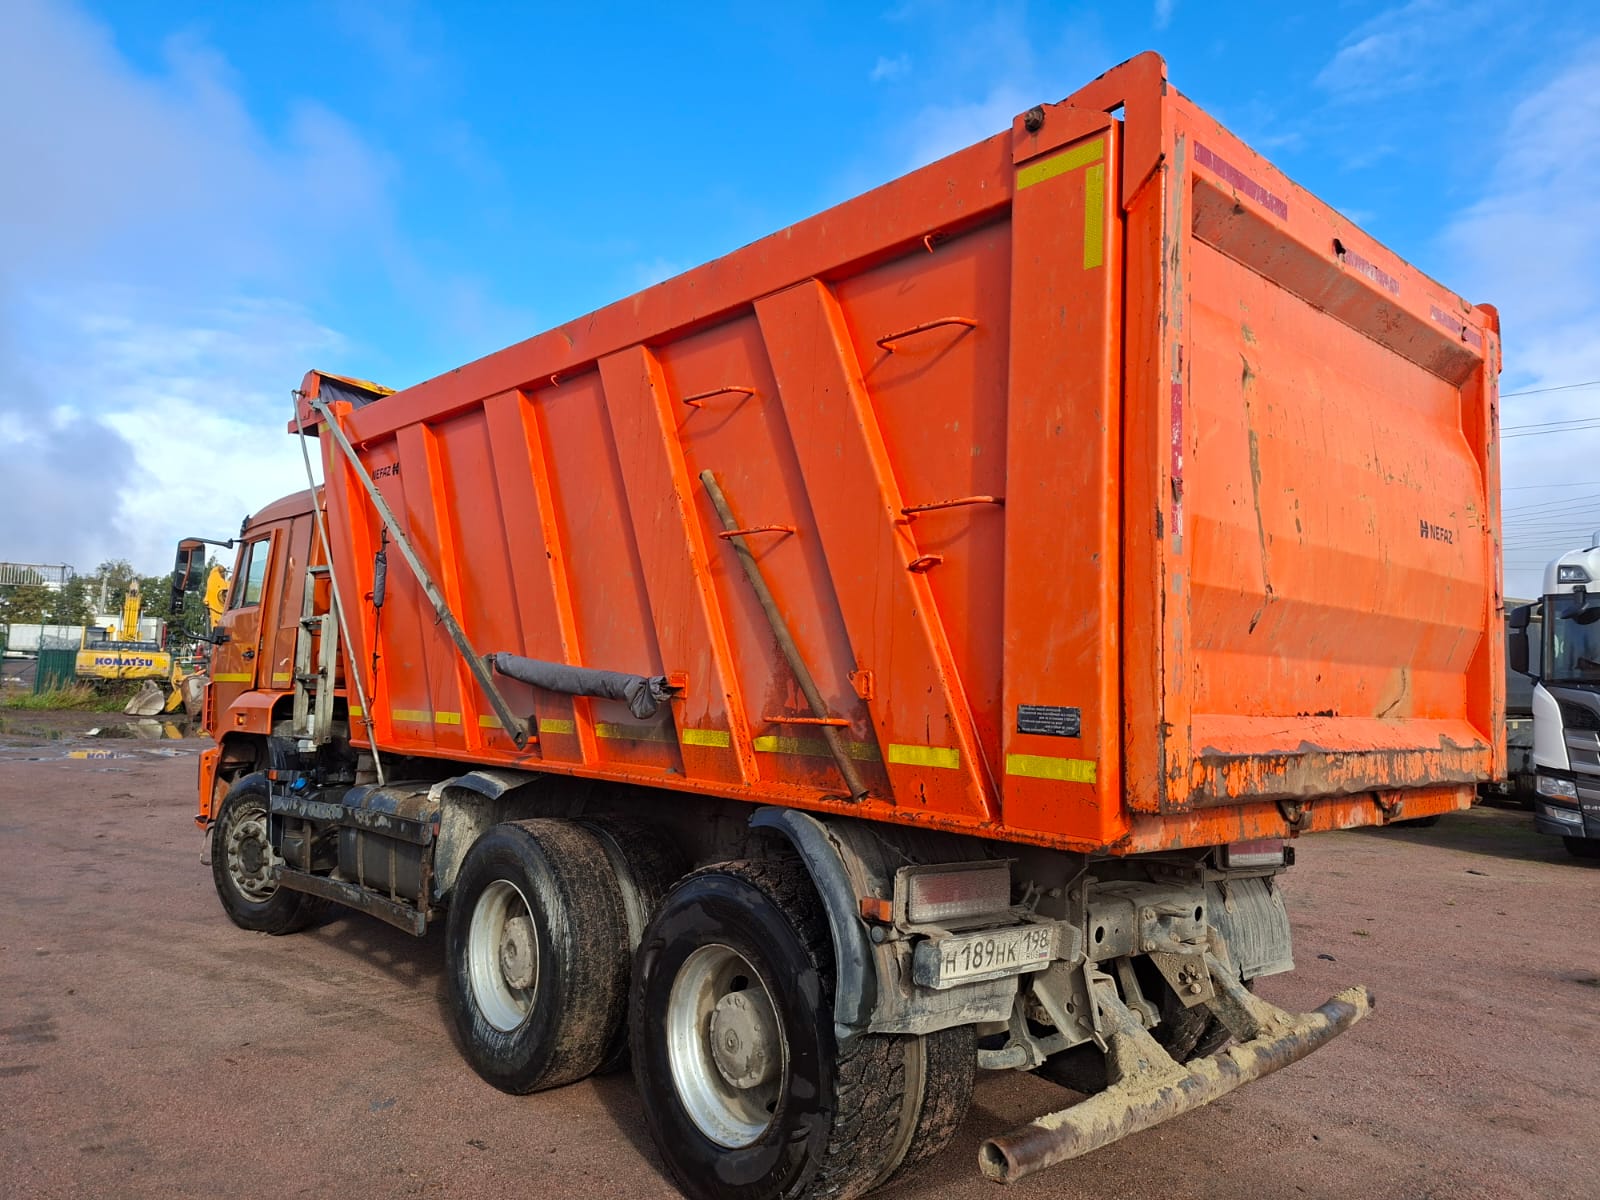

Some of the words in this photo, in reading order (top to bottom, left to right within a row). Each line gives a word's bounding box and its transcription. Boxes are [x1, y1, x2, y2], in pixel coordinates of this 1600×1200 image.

[372, 465, 391, 480] NEFAZ
[1430, 524, 1453, 545] NEFAZ
[95, 657, 153, 667] KOMATSU
